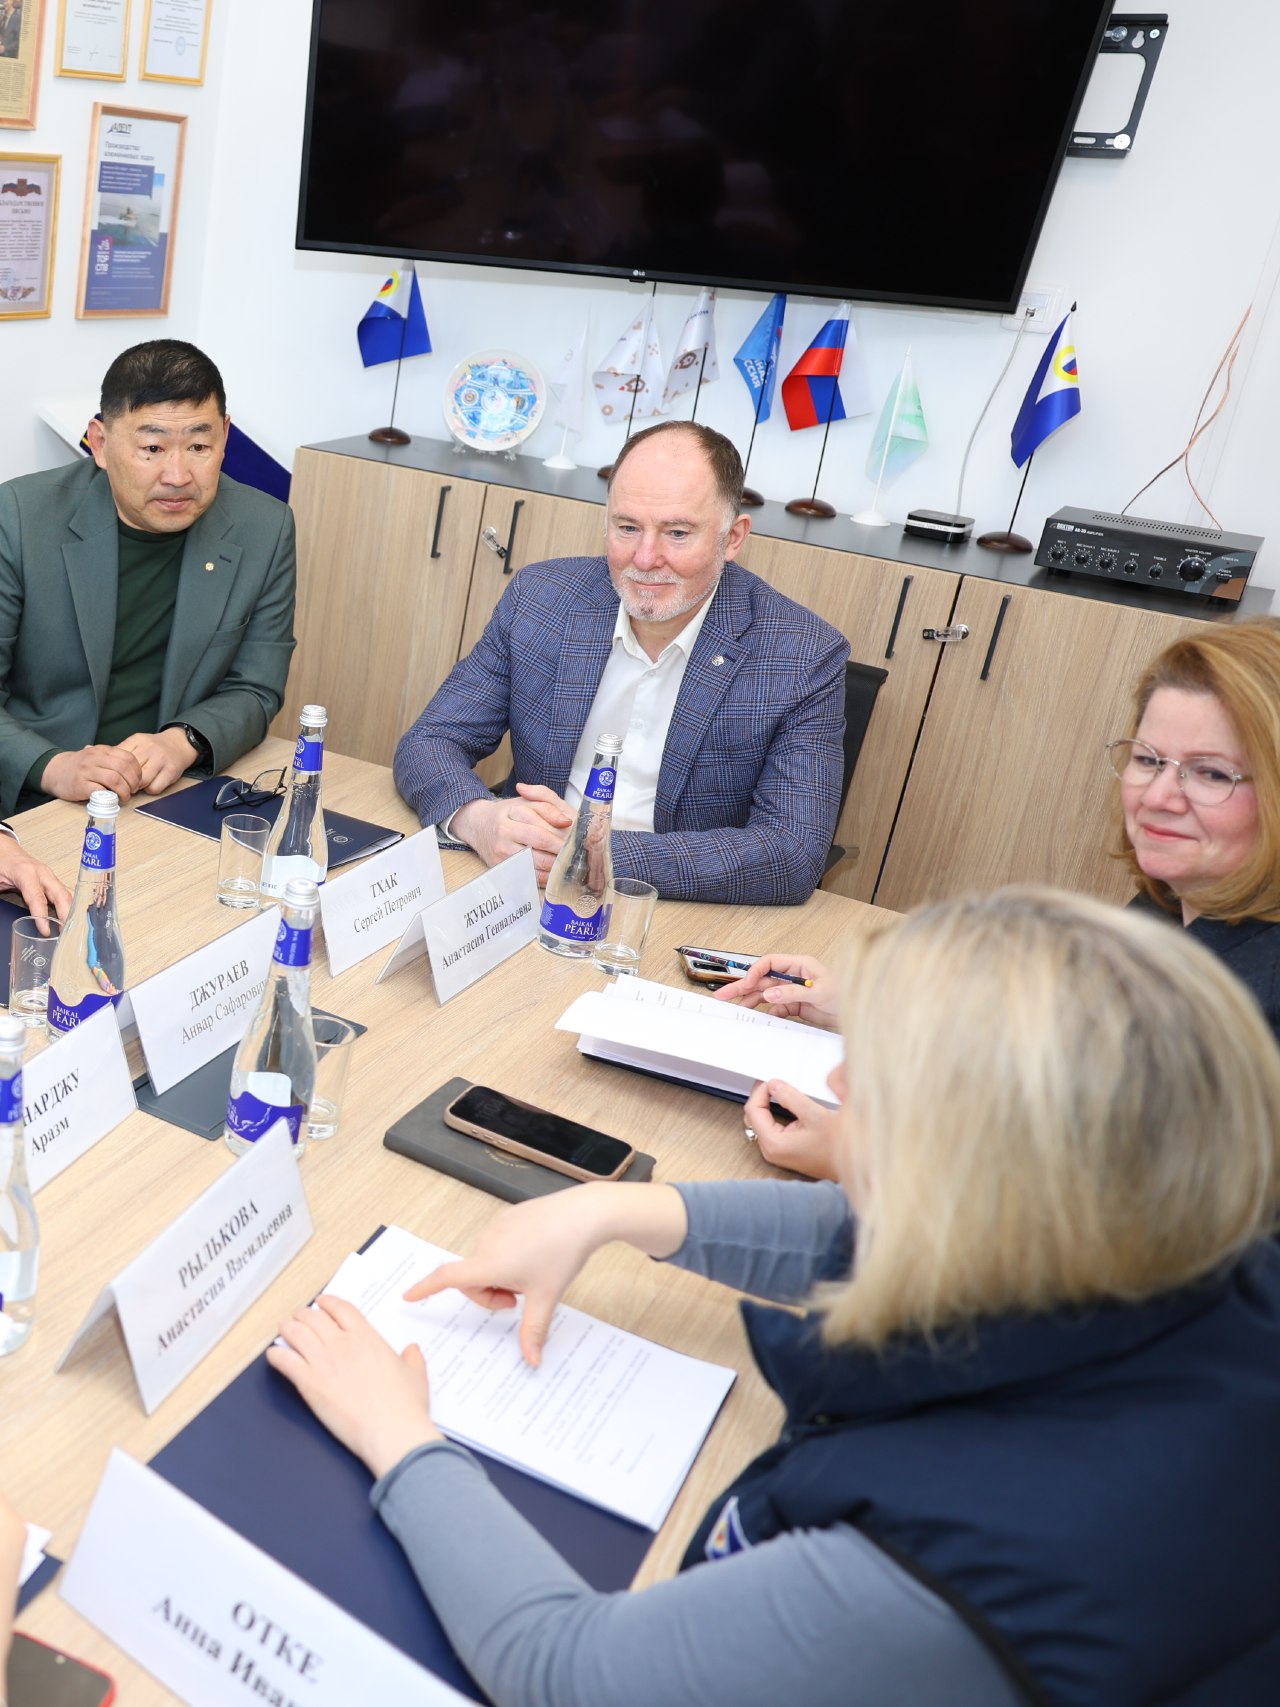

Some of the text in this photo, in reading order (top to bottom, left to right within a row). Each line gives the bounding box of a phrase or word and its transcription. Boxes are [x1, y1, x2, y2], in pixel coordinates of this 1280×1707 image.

[370, 872, 399, 899] ТХАК
[353, 886, 422, 934] Сергей Петрович
[463, 892, 505, 929] ЖУКОВА
[565, 924, 595, 935] PEARL
[571, 920, 593, 928] BAIKAL
[442, 934, 485, 970] Анастасия
[485, 901, 533, 940] Геннадьевна
[189, 960, 249, 1013] ДЖУРАЕВ
[57, 1006, 79, 1019] BAIKAL
[182, 1015, 214, 1044] Анвар
[32, 1116, 70, 1156] Аразм
[178, 1199, 259, 1289] РЫЛЬКОВА
[157, 1203, 293, 1356] Анастасия Васильевна
[152, 1595, 302, 1707] Анна Ива
[231, 1601, 322, 1683] ОТКЕ
